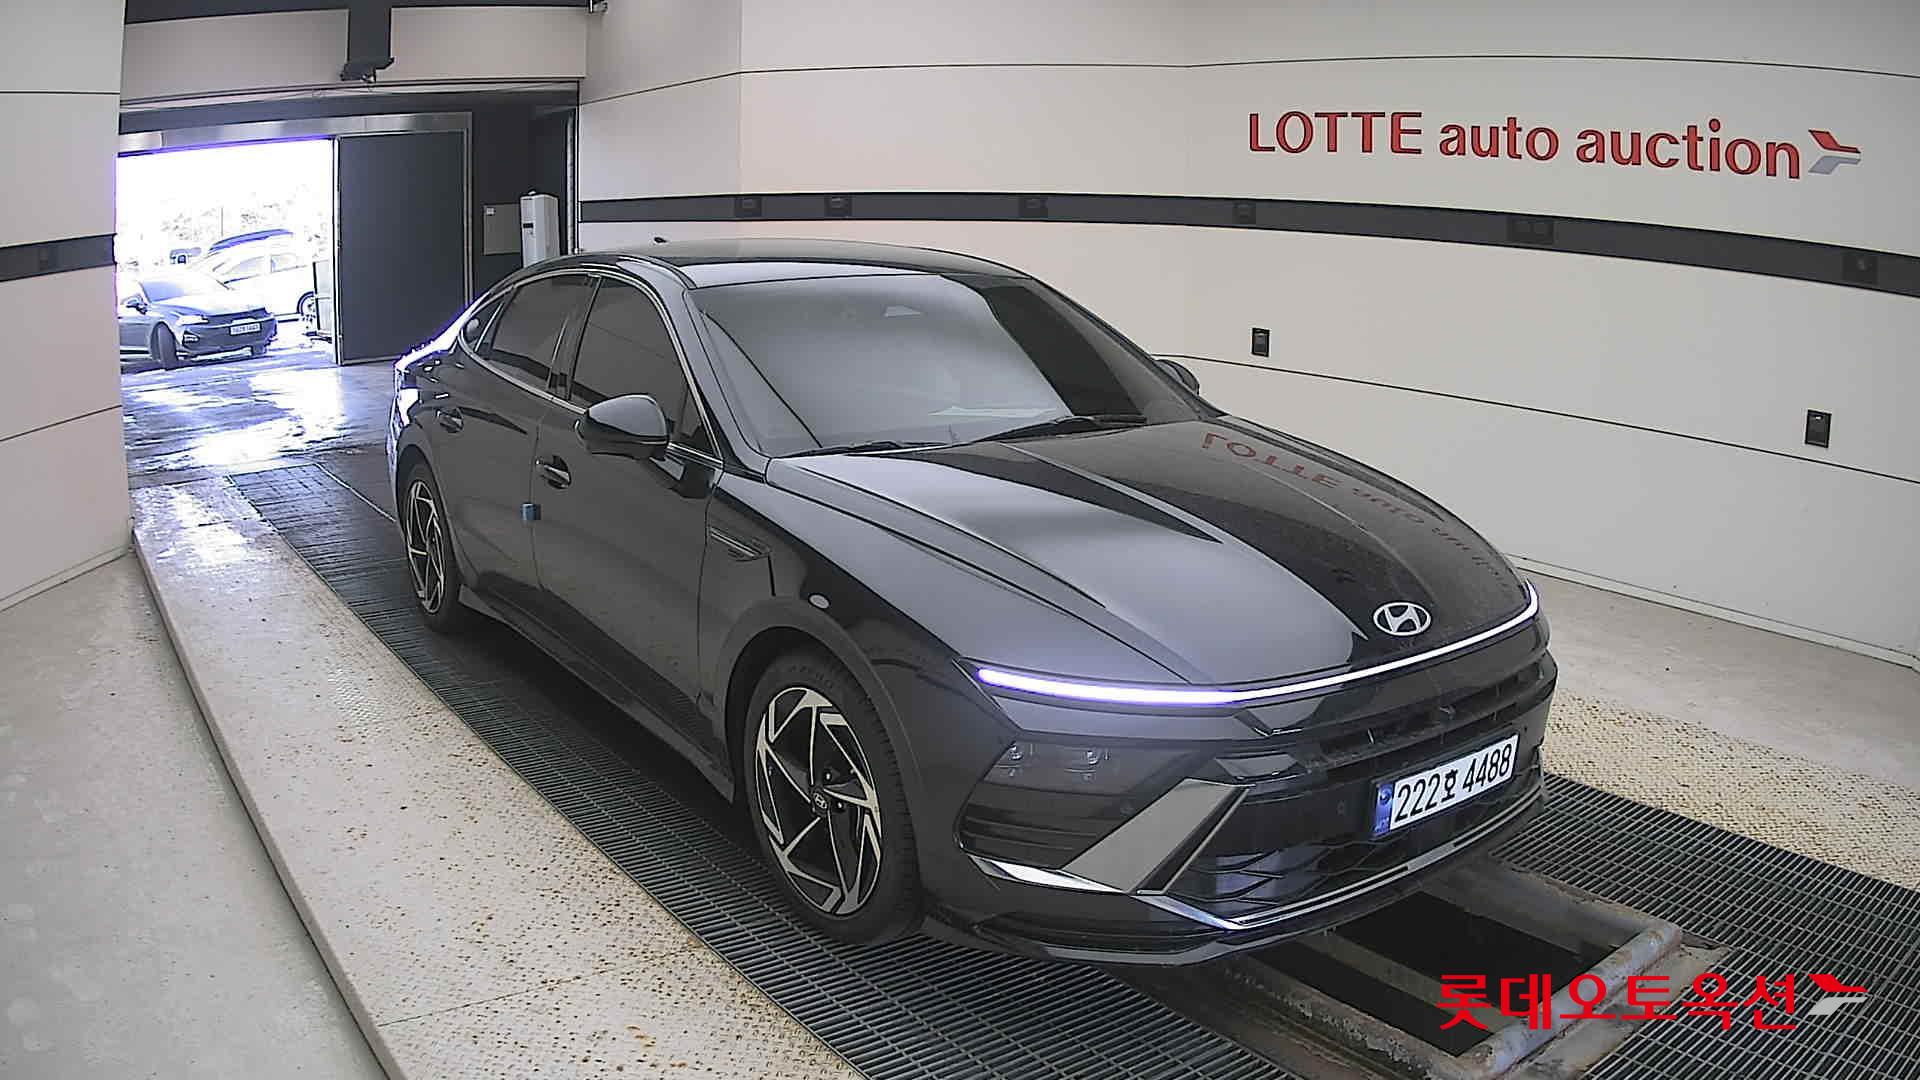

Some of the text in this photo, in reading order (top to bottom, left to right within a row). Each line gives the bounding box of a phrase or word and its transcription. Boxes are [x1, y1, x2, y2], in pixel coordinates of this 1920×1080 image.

[1249, 111, 1801, 178] LOTTE auto auction
[1395, 744, 1512, 822] 222호 4488
